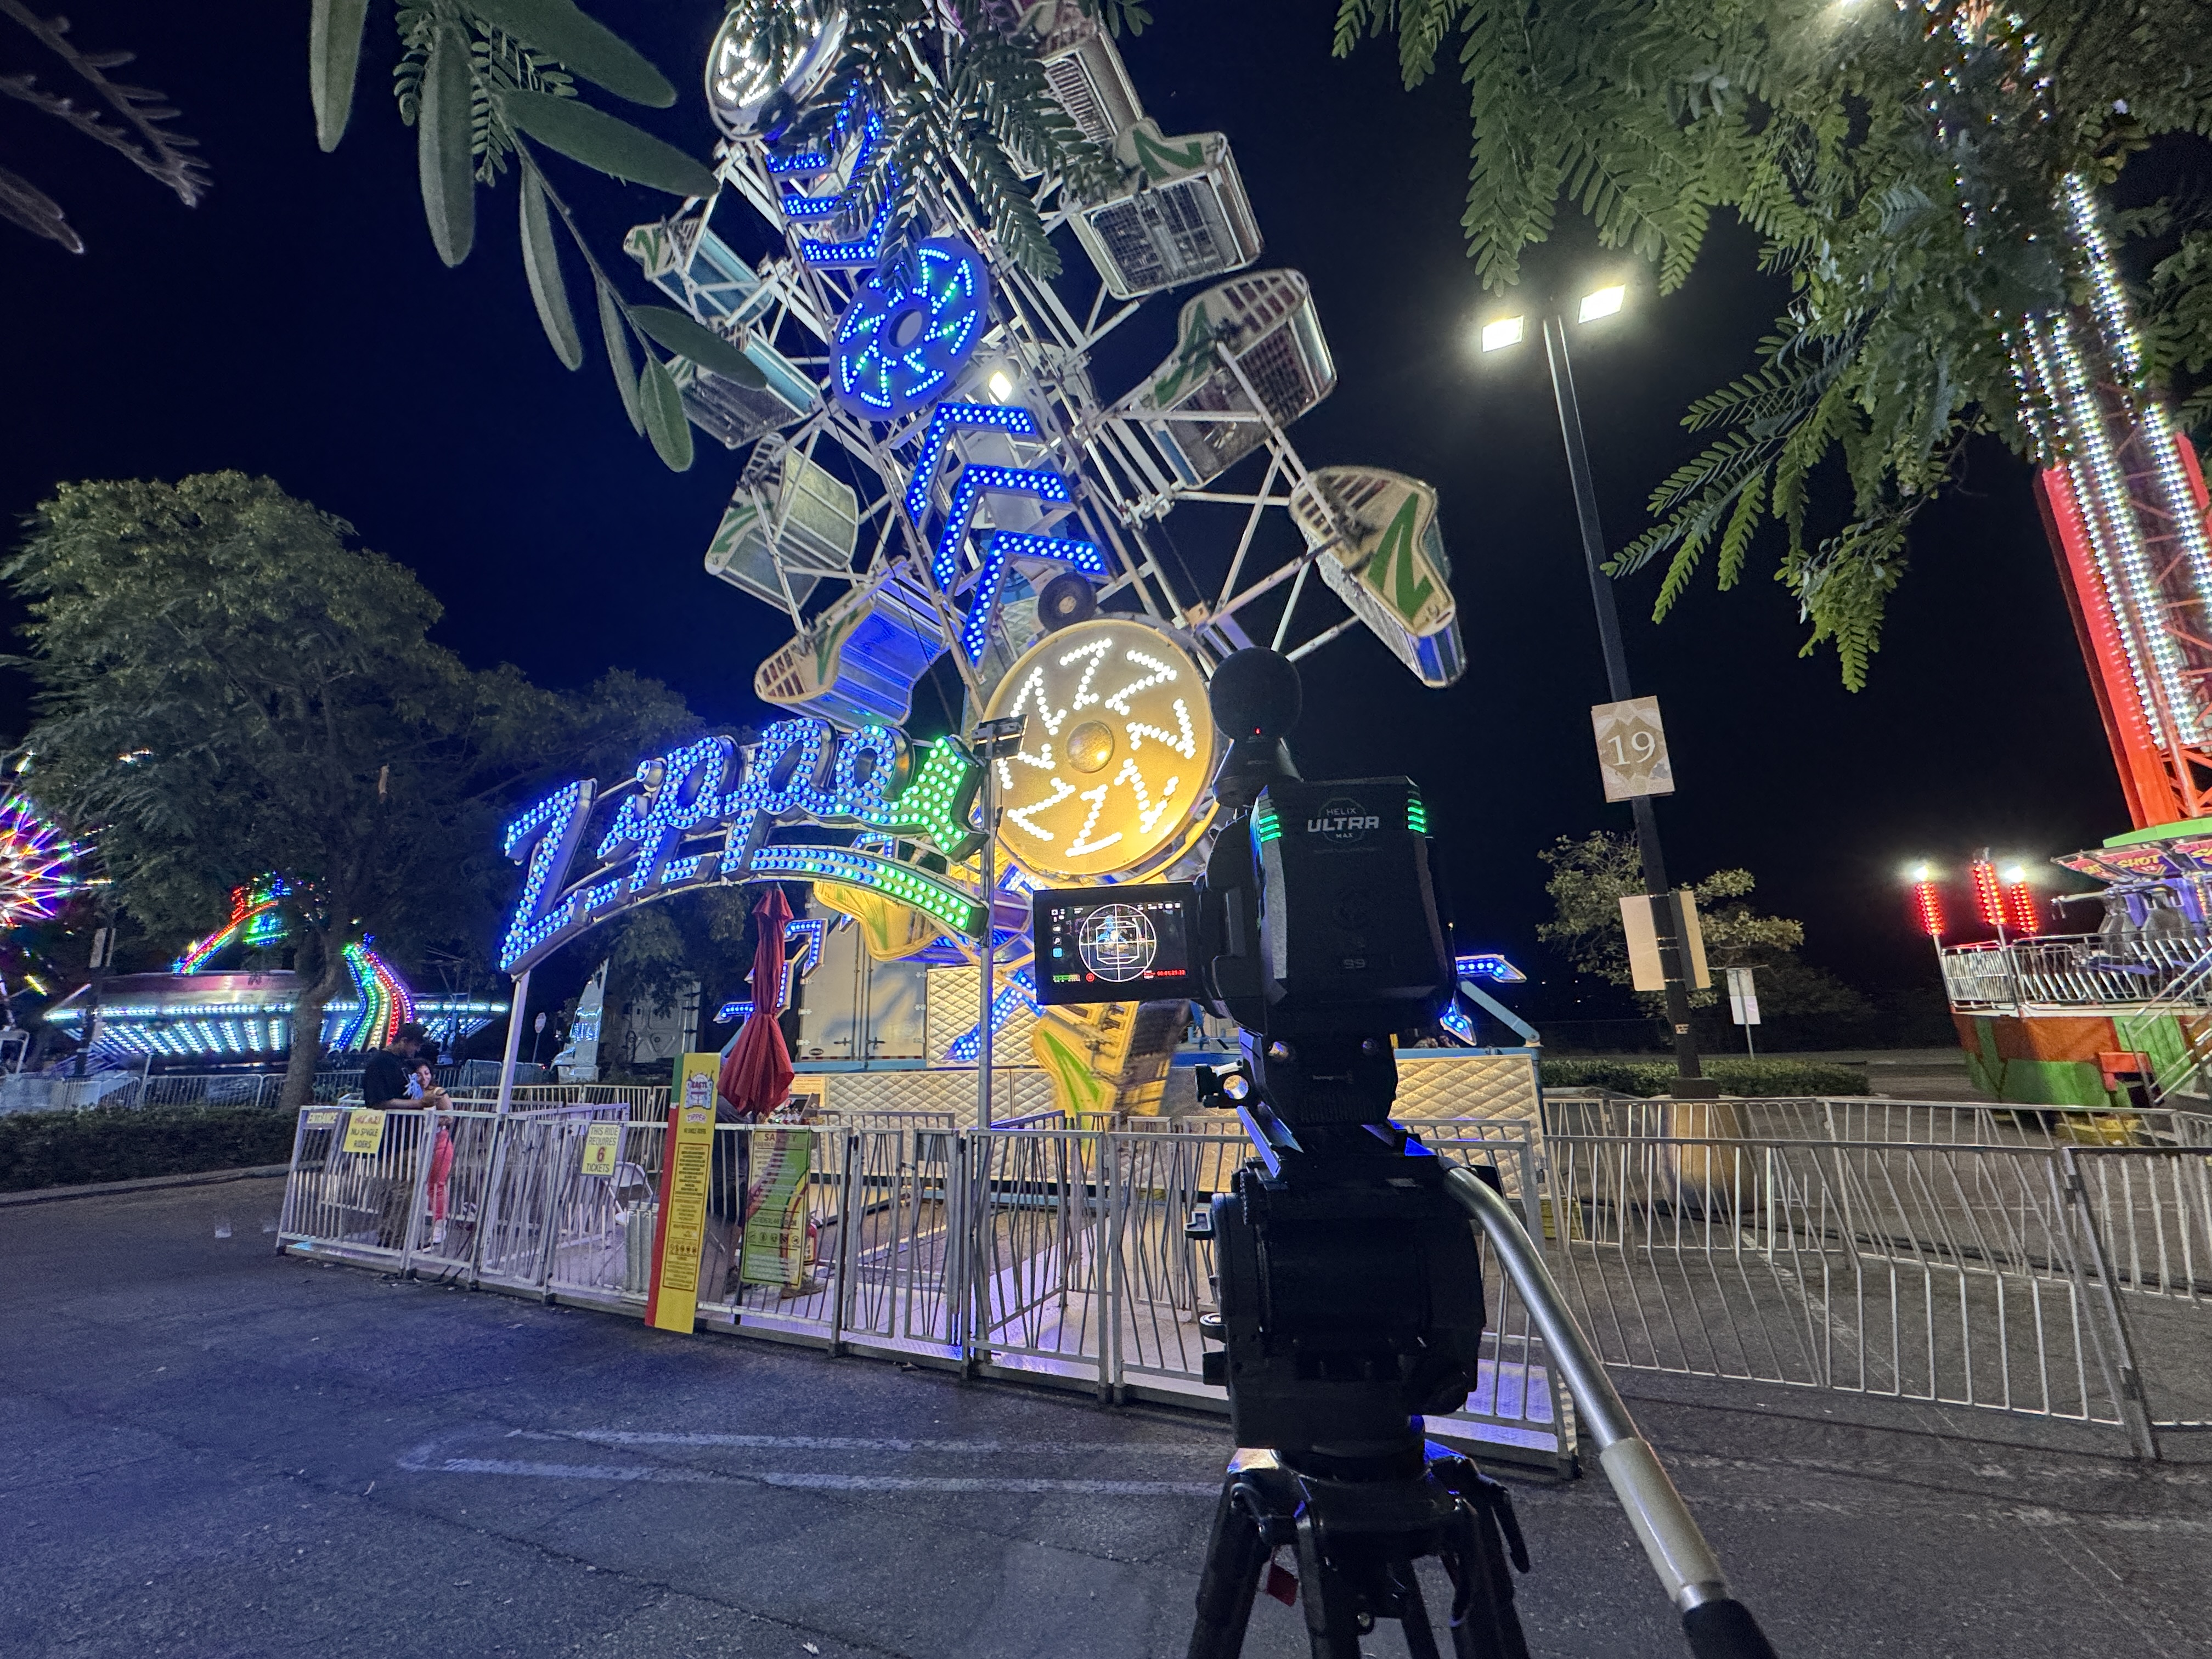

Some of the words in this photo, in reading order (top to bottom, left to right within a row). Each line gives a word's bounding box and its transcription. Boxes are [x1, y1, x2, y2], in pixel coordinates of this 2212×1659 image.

[1607, 731, 1656, 766] 19
[1326, 808, 1357, 816] HELIX
[1307, 816, 1379, 832] ULTRA
[2117, 854, 2162, 868] SHOT
[687, 1113, 706, 1122] ZIPPER
[591, 1127, 603, 1136] THIS
[604, 1127, 619, 1136] RIDE
[588, 1136, 617, 1146] REQUIRES
[597, 1146, 606, 1163] 6
[586, 1163, 610, 1173] TICKETS
